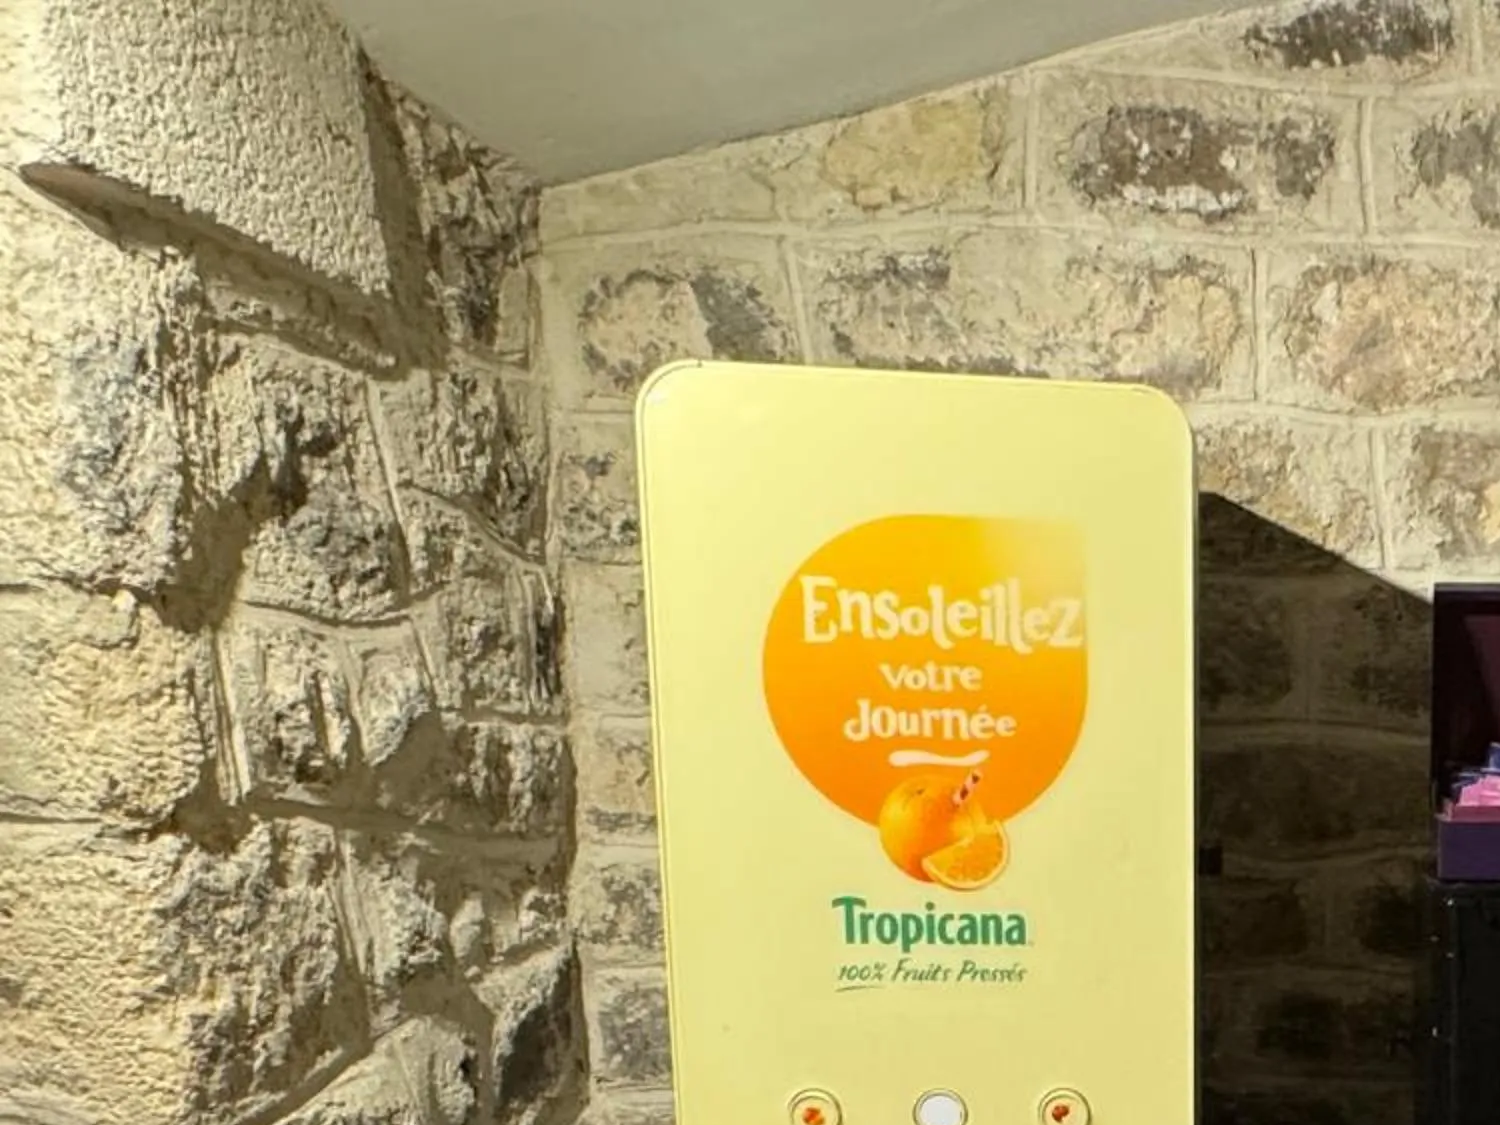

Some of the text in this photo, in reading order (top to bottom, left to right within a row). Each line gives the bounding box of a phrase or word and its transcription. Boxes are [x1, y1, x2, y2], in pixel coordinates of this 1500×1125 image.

[799, 575, 1084, 655] Ensoleillez
[879, 660, 983, 692] votre
[832, 896, 1026, 953] Tropicana
[838, 957, 1029, 982] 100% Fruits Pressés
